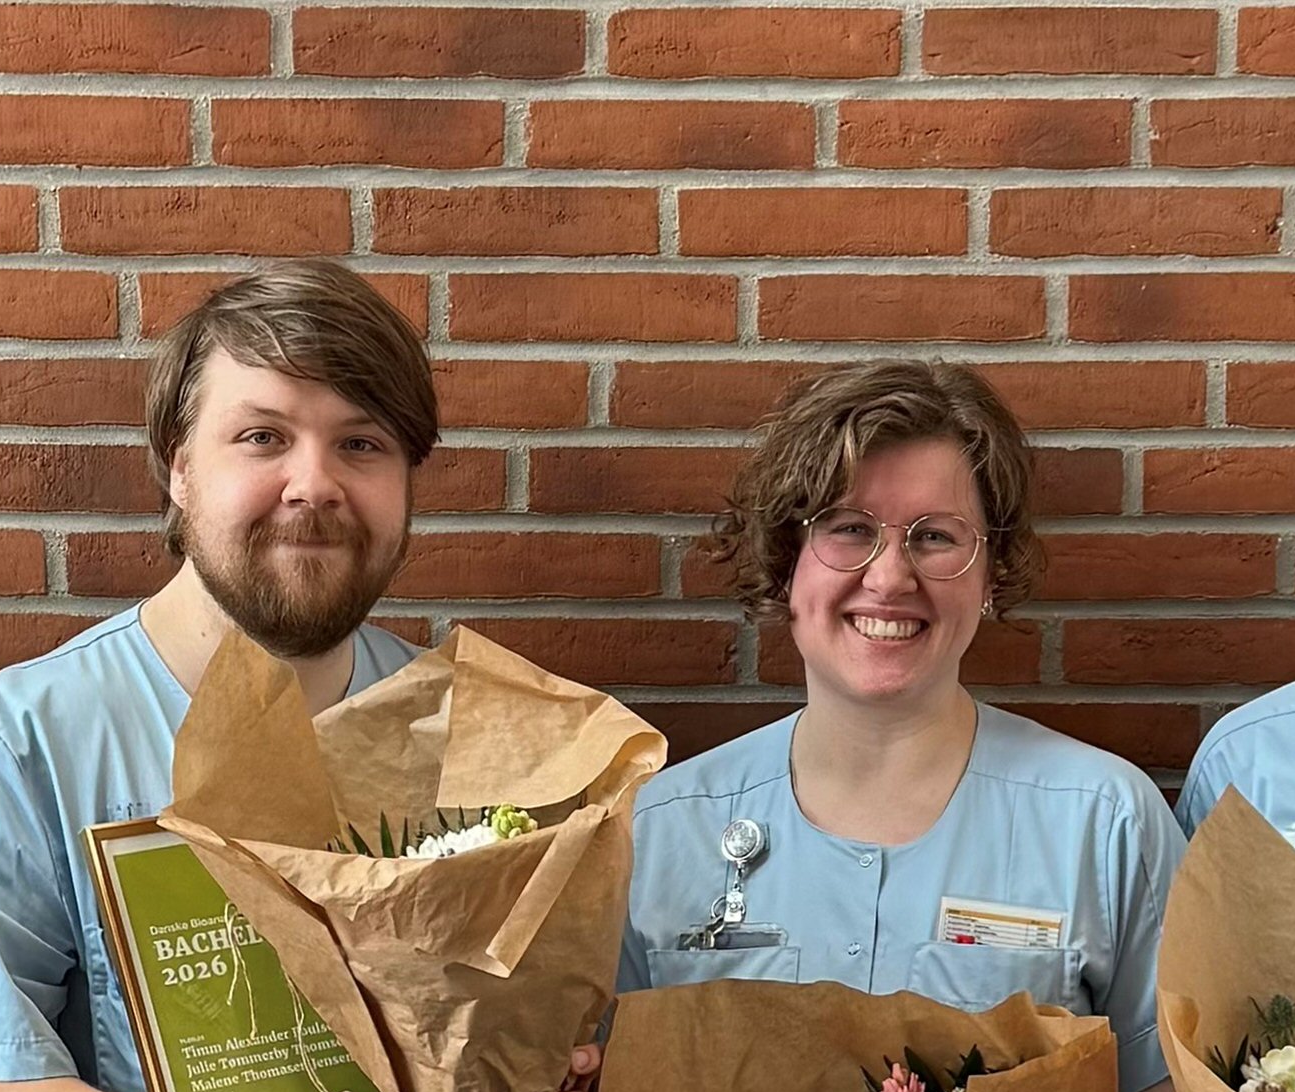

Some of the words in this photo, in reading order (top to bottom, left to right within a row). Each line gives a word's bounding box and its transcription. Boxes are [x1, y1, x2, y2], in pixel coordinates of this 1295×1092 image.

[149, 922, 188, 936] Danske
[153, 924, 263, 961] BACHEL
[162, 955, 227, 986] 2026
[181, 1044, 223, 1059] Timm
[225, 1030, 289, 1052] Alexander
[186, 1060, 216, 1079] Julie
[218, 1047, 289, 1069] Tømmerby
[190, 1076, 241, 1092] Malene
